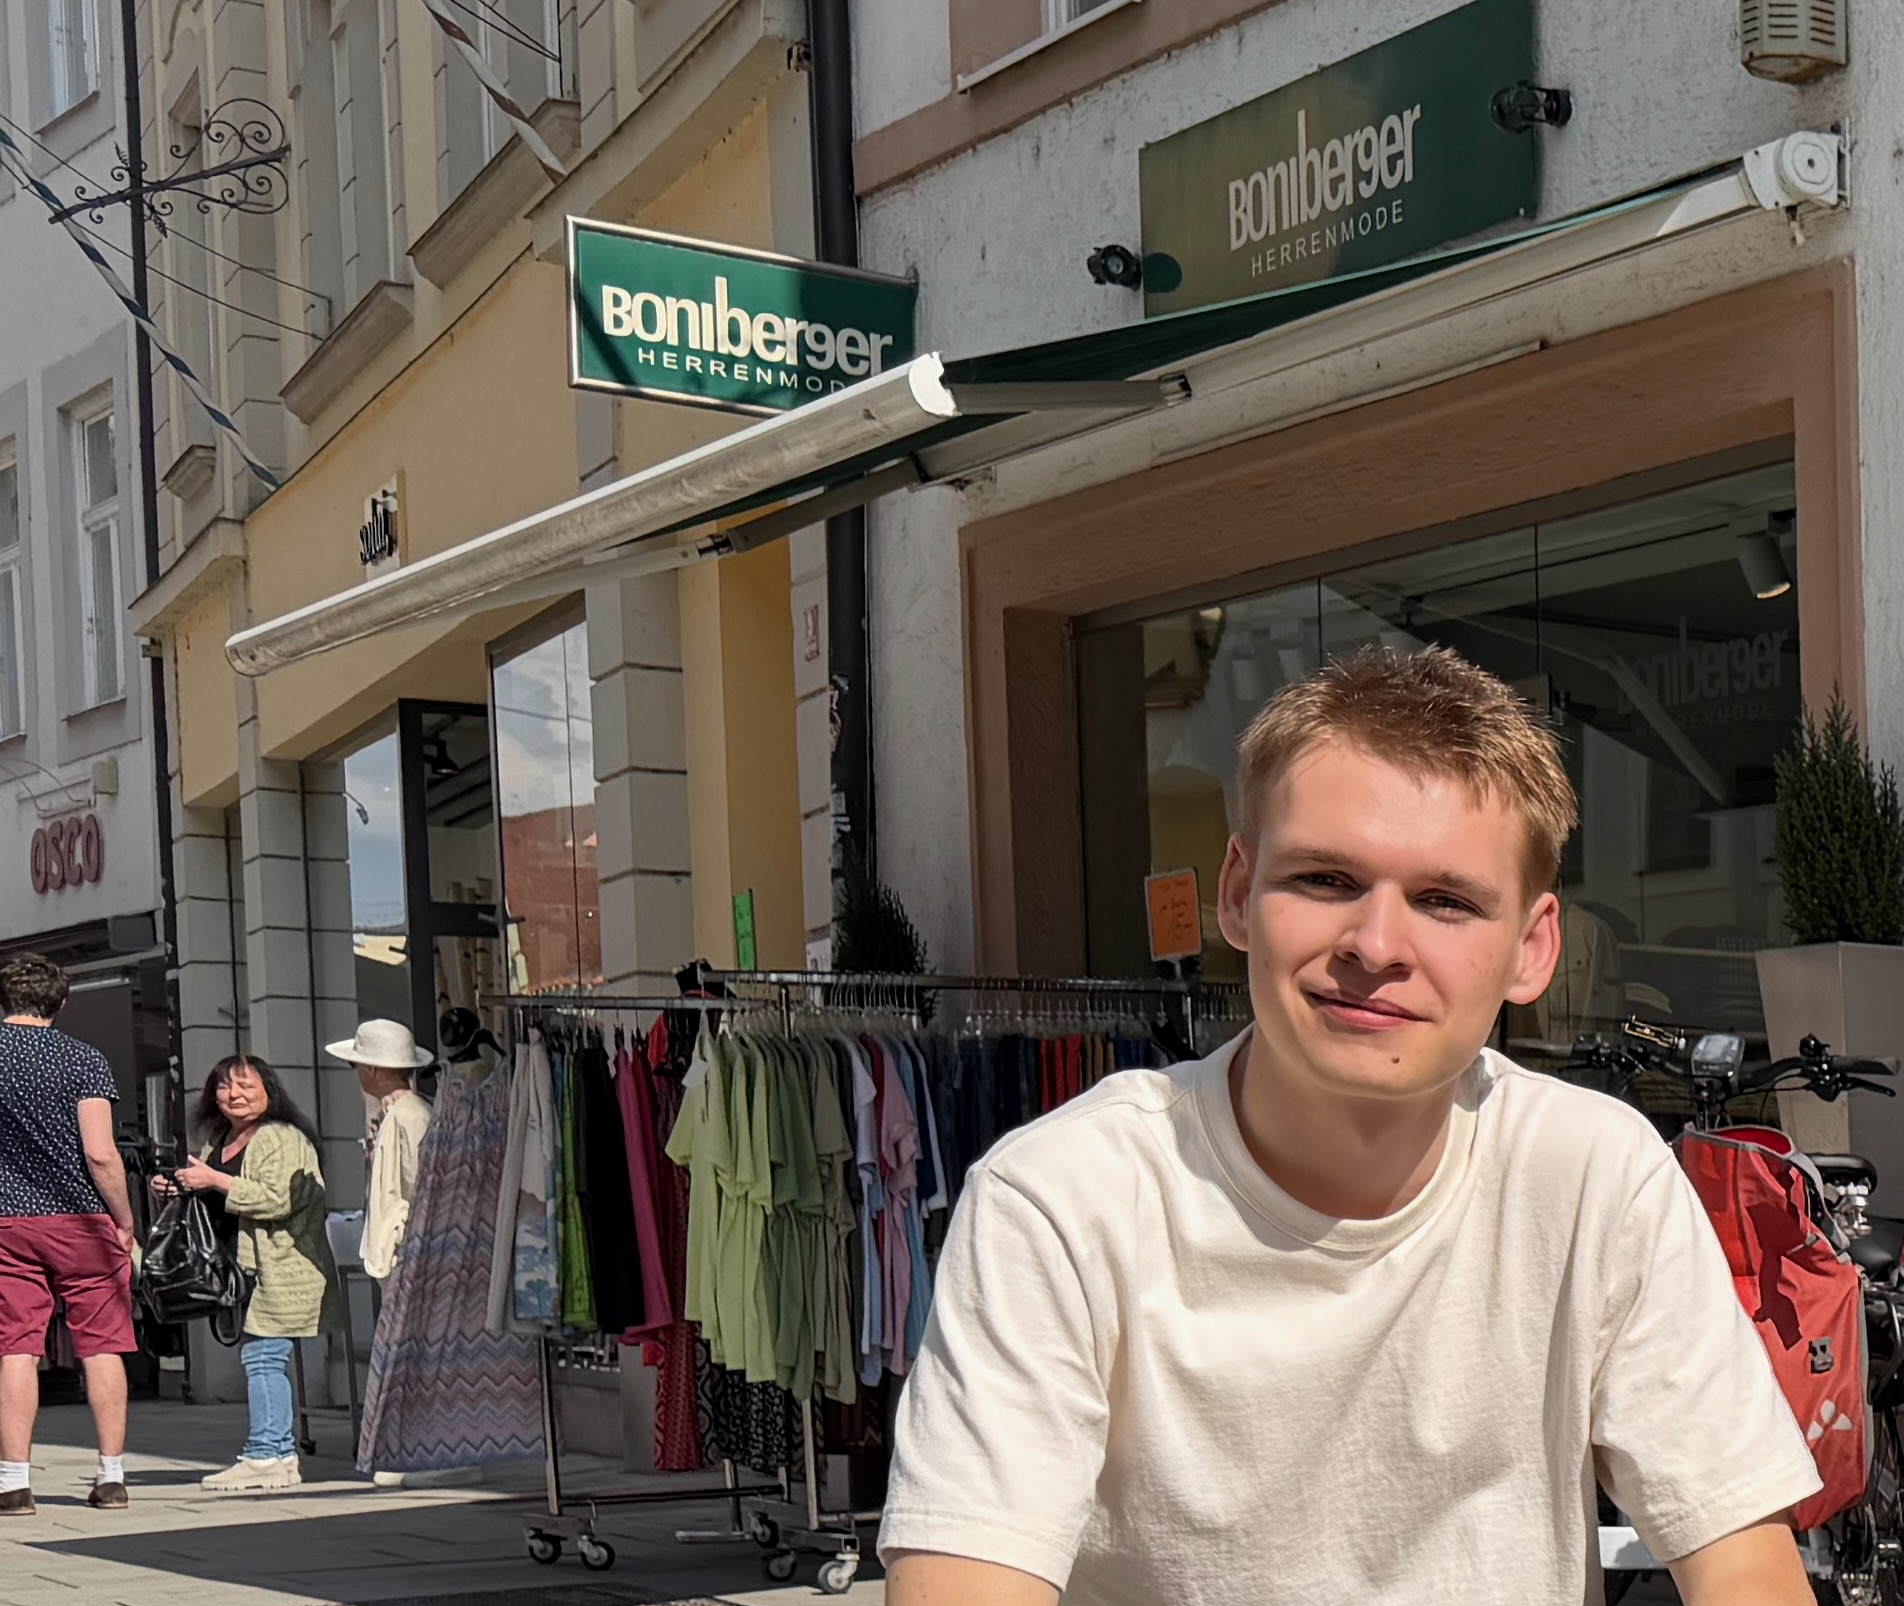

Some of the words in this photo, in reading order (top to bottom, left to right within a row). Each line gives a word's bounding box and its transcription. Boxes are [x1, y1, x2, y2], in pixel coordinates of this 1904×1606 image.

[1228, 103, 1421, 251] Boniberger
[1251, 199, 1403, 277] HERRENMODE
[601, 275, 893, 378] Boniberger
[638, 348, 846, 394] HERRENMOD
[30, 813, 102, 895] OSCO
